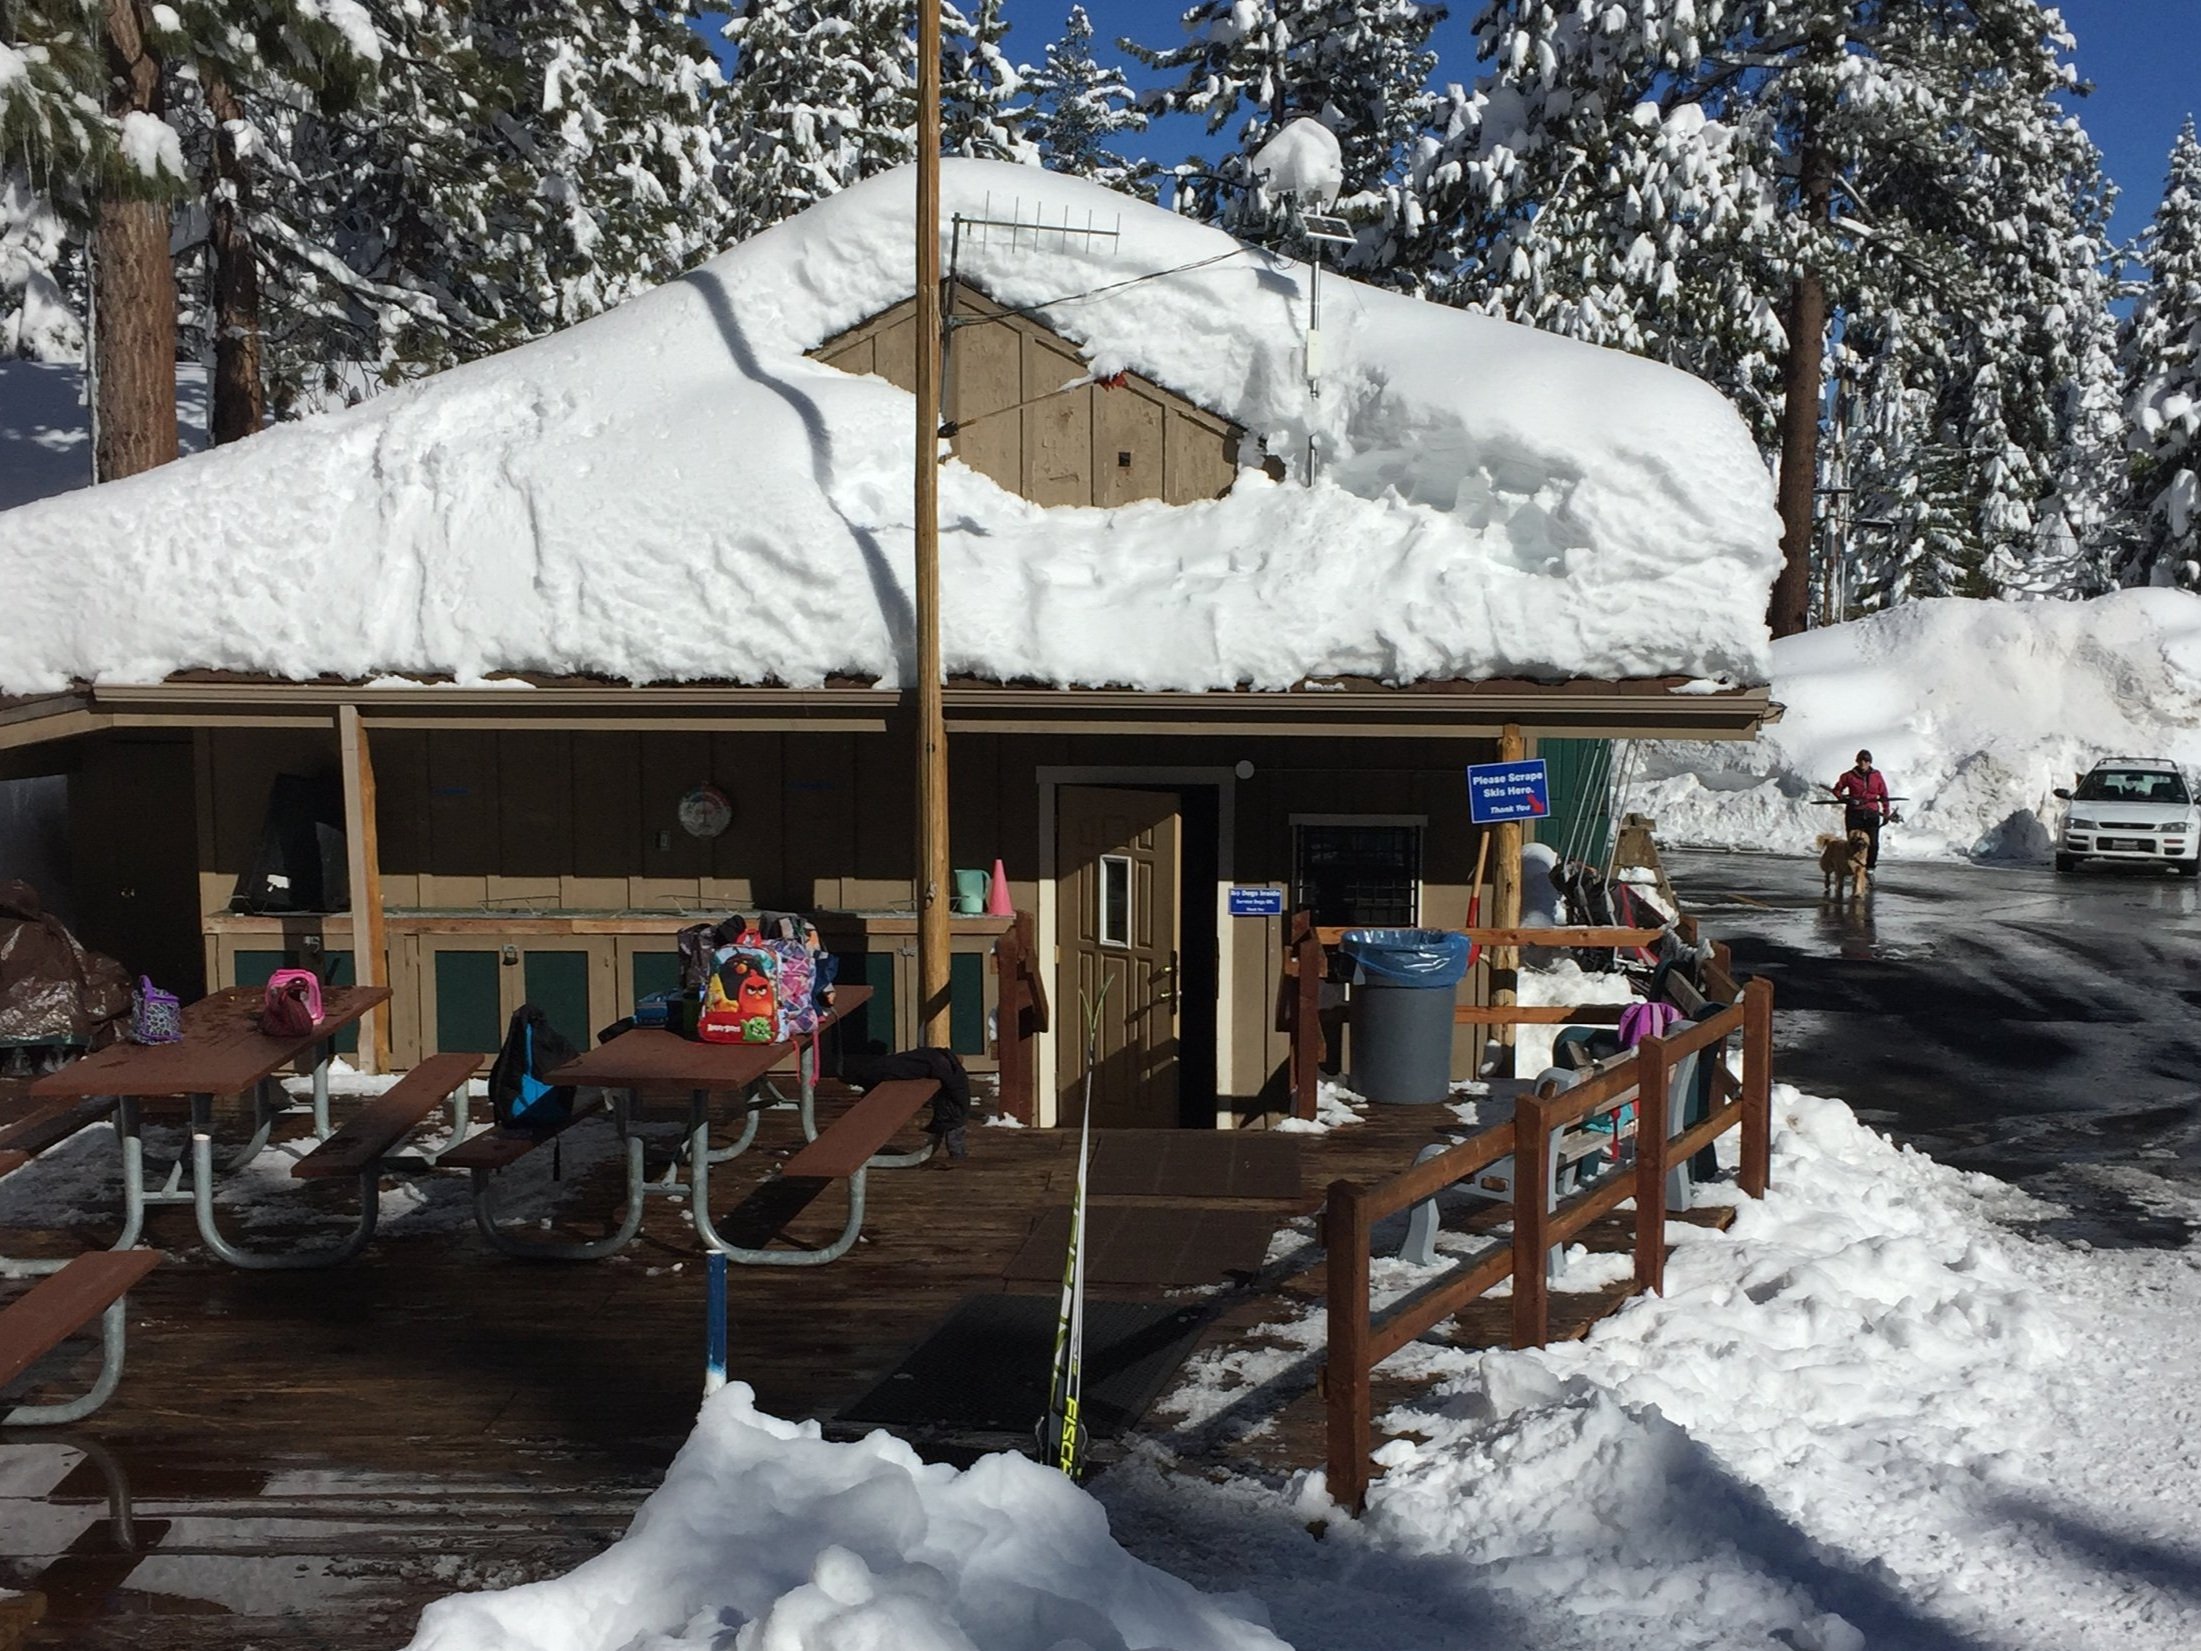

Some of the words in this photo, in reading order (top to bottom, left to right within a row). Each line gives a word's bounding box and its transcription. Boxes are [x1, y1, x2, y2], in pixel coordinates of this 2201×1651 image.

[1473, 775, 1506, 786] Please
[1507, 772, 1543, 782] Scrape
[1483, 788, 1506, 798] Skis
[1507, 786, 1535, 796] Here.
[1490, 804, 1514, 814] Thank
[1515, 804, 1531, 812] You
